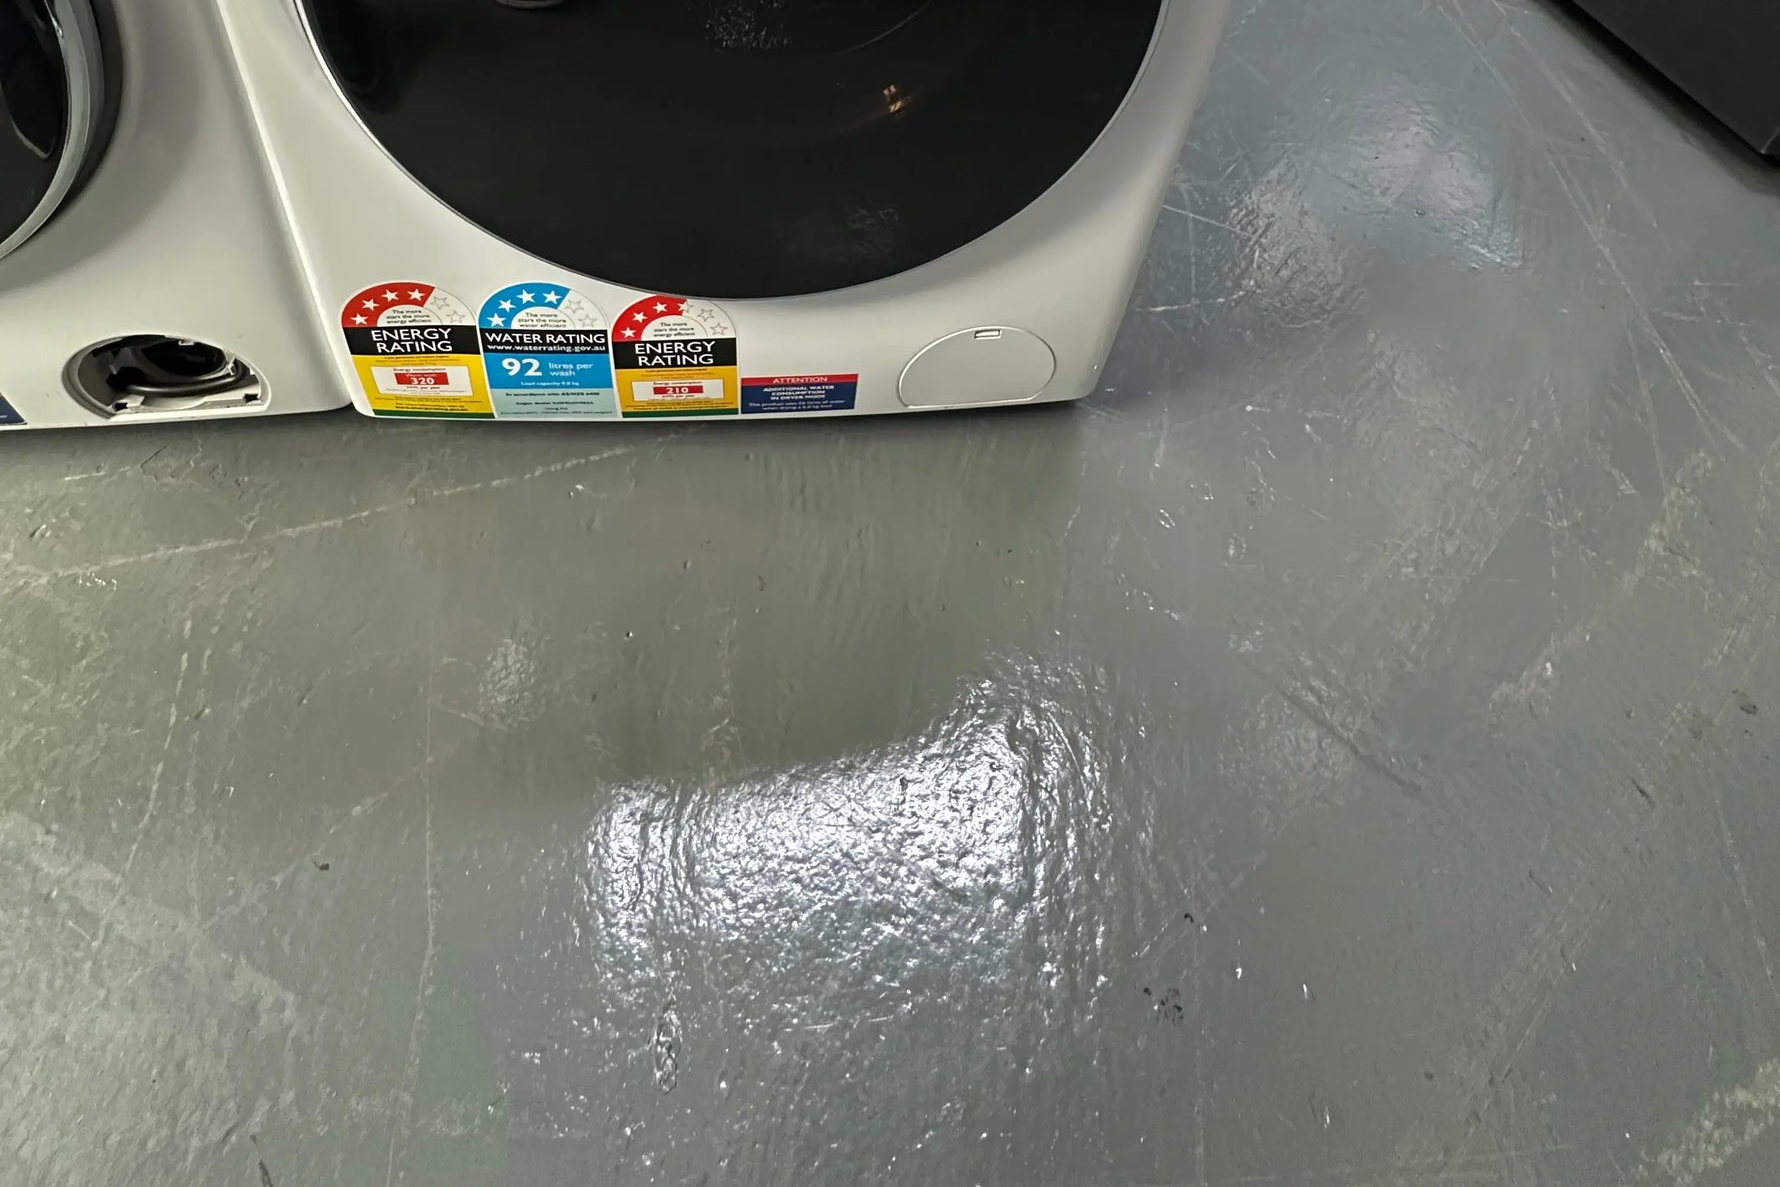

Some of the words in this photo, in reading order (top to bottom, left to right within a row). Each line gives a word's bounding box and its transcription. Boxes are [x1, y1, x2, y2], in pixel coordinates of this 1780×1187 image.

[370, 328, 452, 342] ENERGY
[485, 332, 542, 344] WATER
[546, 334, 606, 344] RATING
[376, 340, 452, 353] RATING
[486, 344, 606, 352] www.waterrating.gov.au
[634, 340, 716, 354] ENERGY
[638, 354, 714, 366] RATING
[502, 358, 542, 376] 92
[576, 362, 594, 372] per
